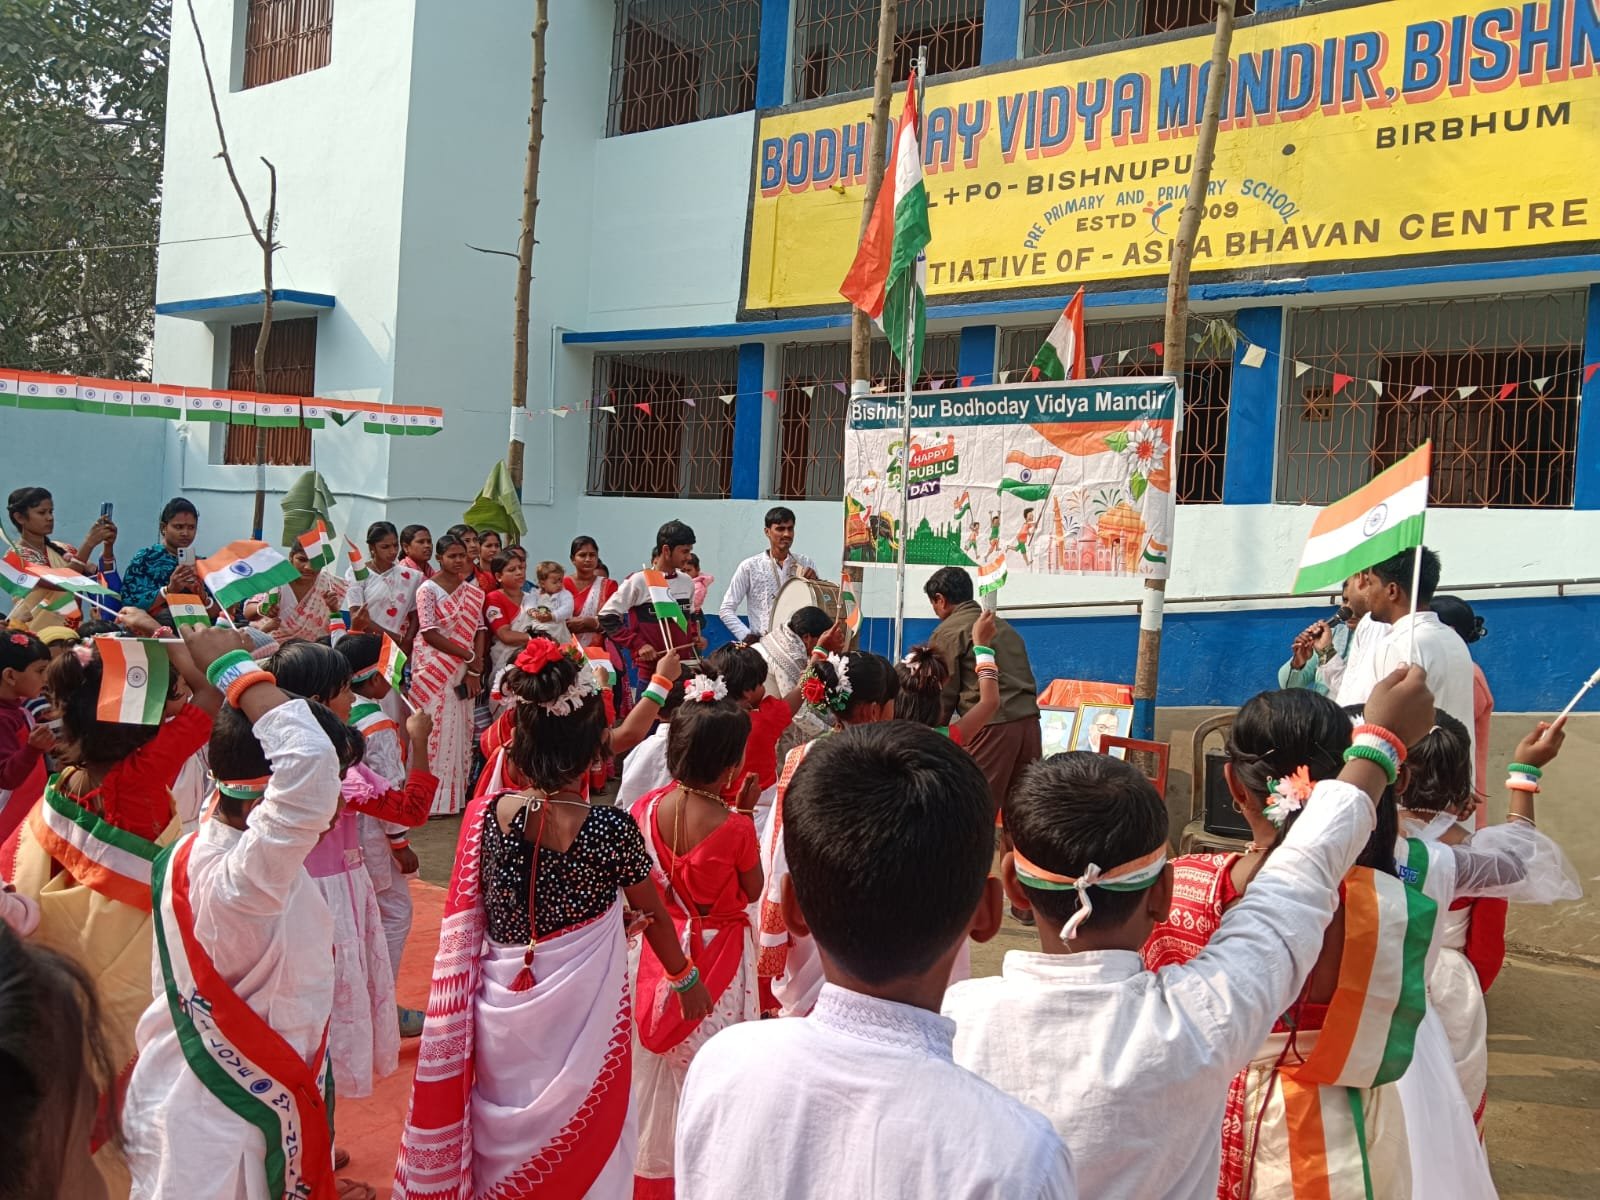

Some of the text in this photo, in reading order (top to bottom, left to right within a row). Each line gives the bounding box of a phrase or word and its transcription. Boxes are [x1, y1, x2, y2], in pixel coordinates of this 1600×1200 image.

[760, 98, 989, 198] BODHAY
[997, 71, 1152, 164] VIDYA
[1376, 101, 1572, 149] BIRBHUM
[1023, 178, 1300, 250] PRE PRIMARY AND PRIMRY SCHOOL
[1056, 246, 1094, 272] OF
[1122, 236, 1213, 266] ASA
[1225, 218, 1380, 257] BHAVAN
[1399, 197, 1588, 241] CENTRE
[1076, 212, 1137, 233] ESTD
[940, 396, 1029, 419] Bodhoday
[1034, 393, 1089, 418] Vidya
[1095, 390, 1166, 412] Mandir
[914, 448, 947, 464] HAPPY
[910, 481, 937, 497] DAY
[210, 1038, 254, 1078] LOVE
[272, 1092, 290, 1113] MY
